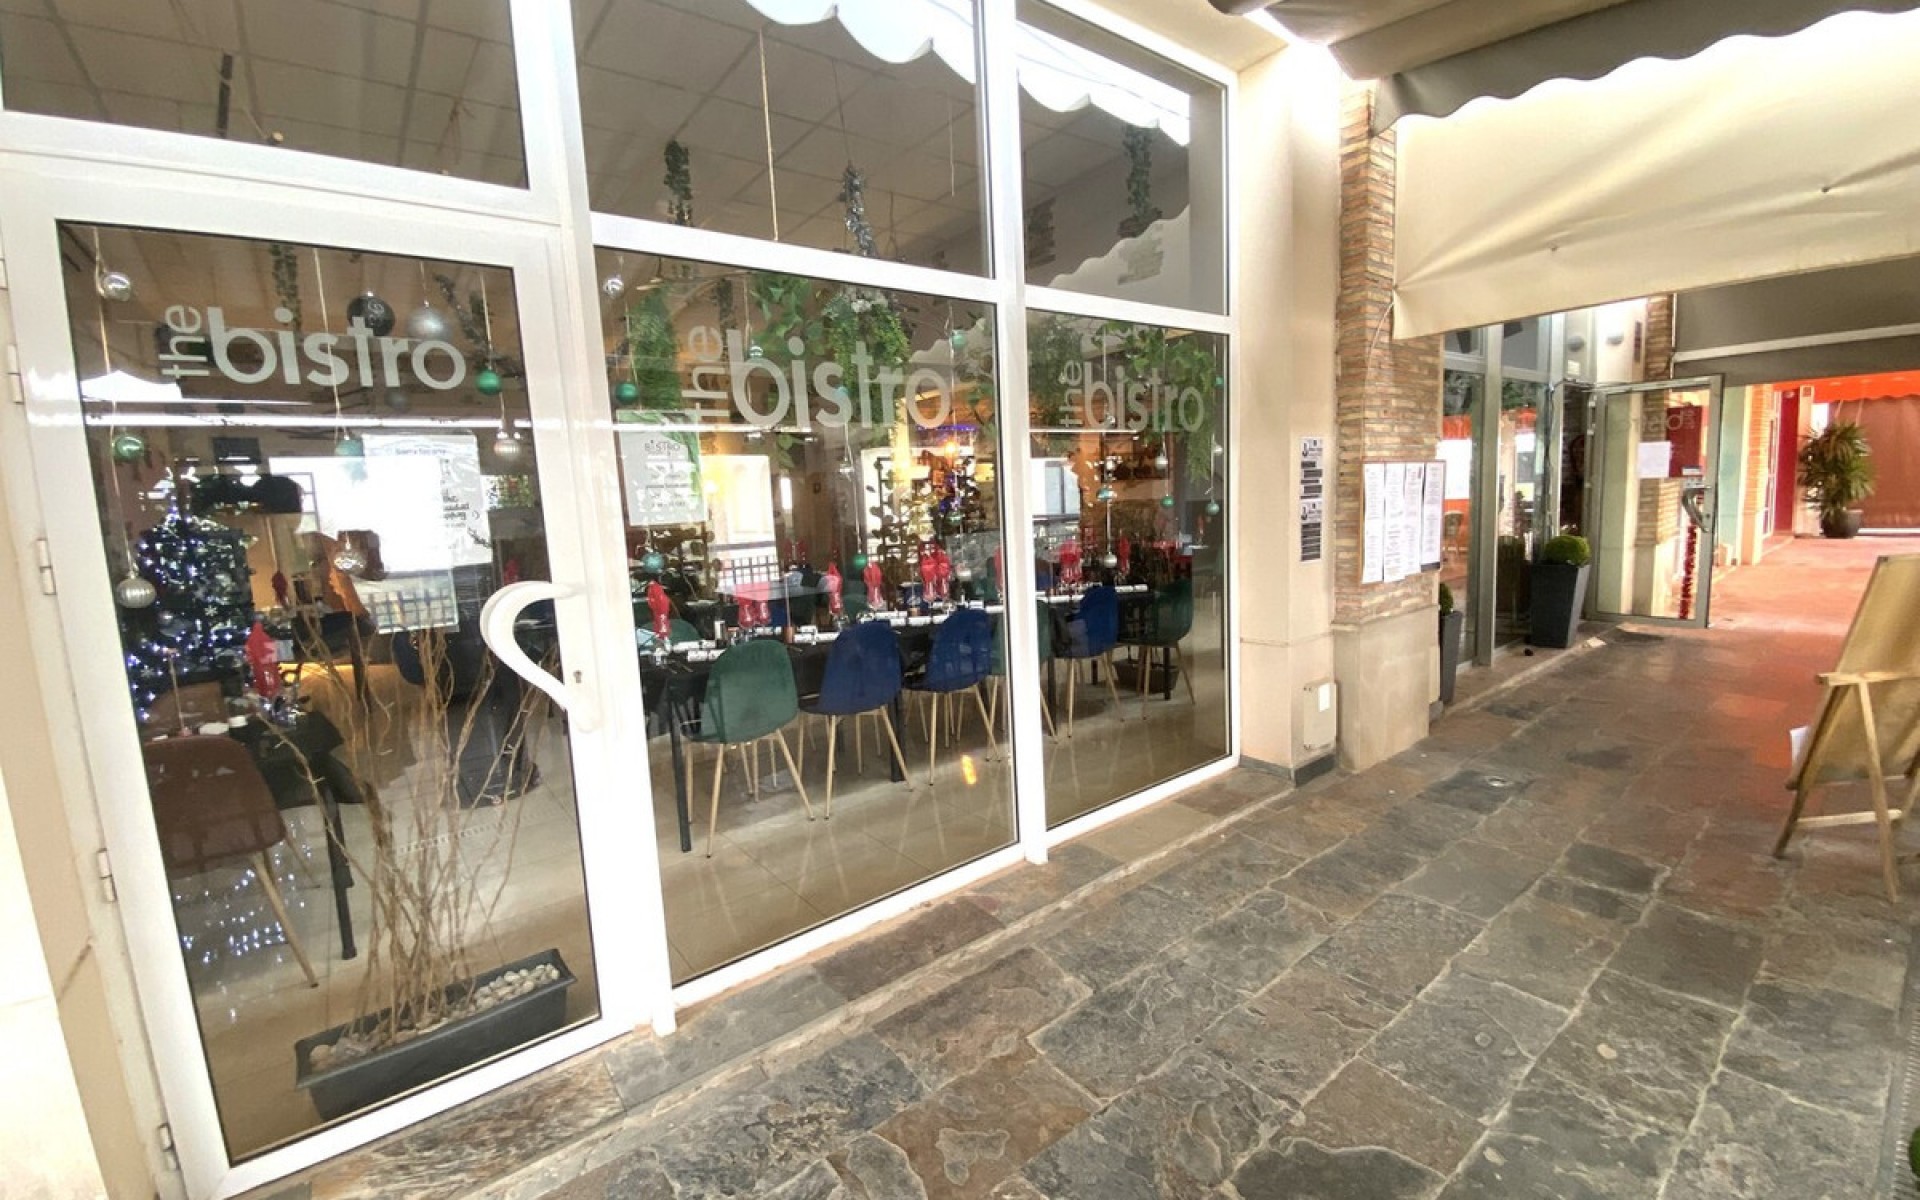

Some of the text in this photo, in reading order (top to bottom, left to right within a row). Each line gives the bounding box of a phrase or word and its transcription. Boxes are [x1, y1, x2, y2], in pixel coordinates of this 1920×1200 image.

[159, 304, 467, 390] the bistro
[682, 325, 951, 430] the bistro
[1058, 360, 1204, 433] the bistro
